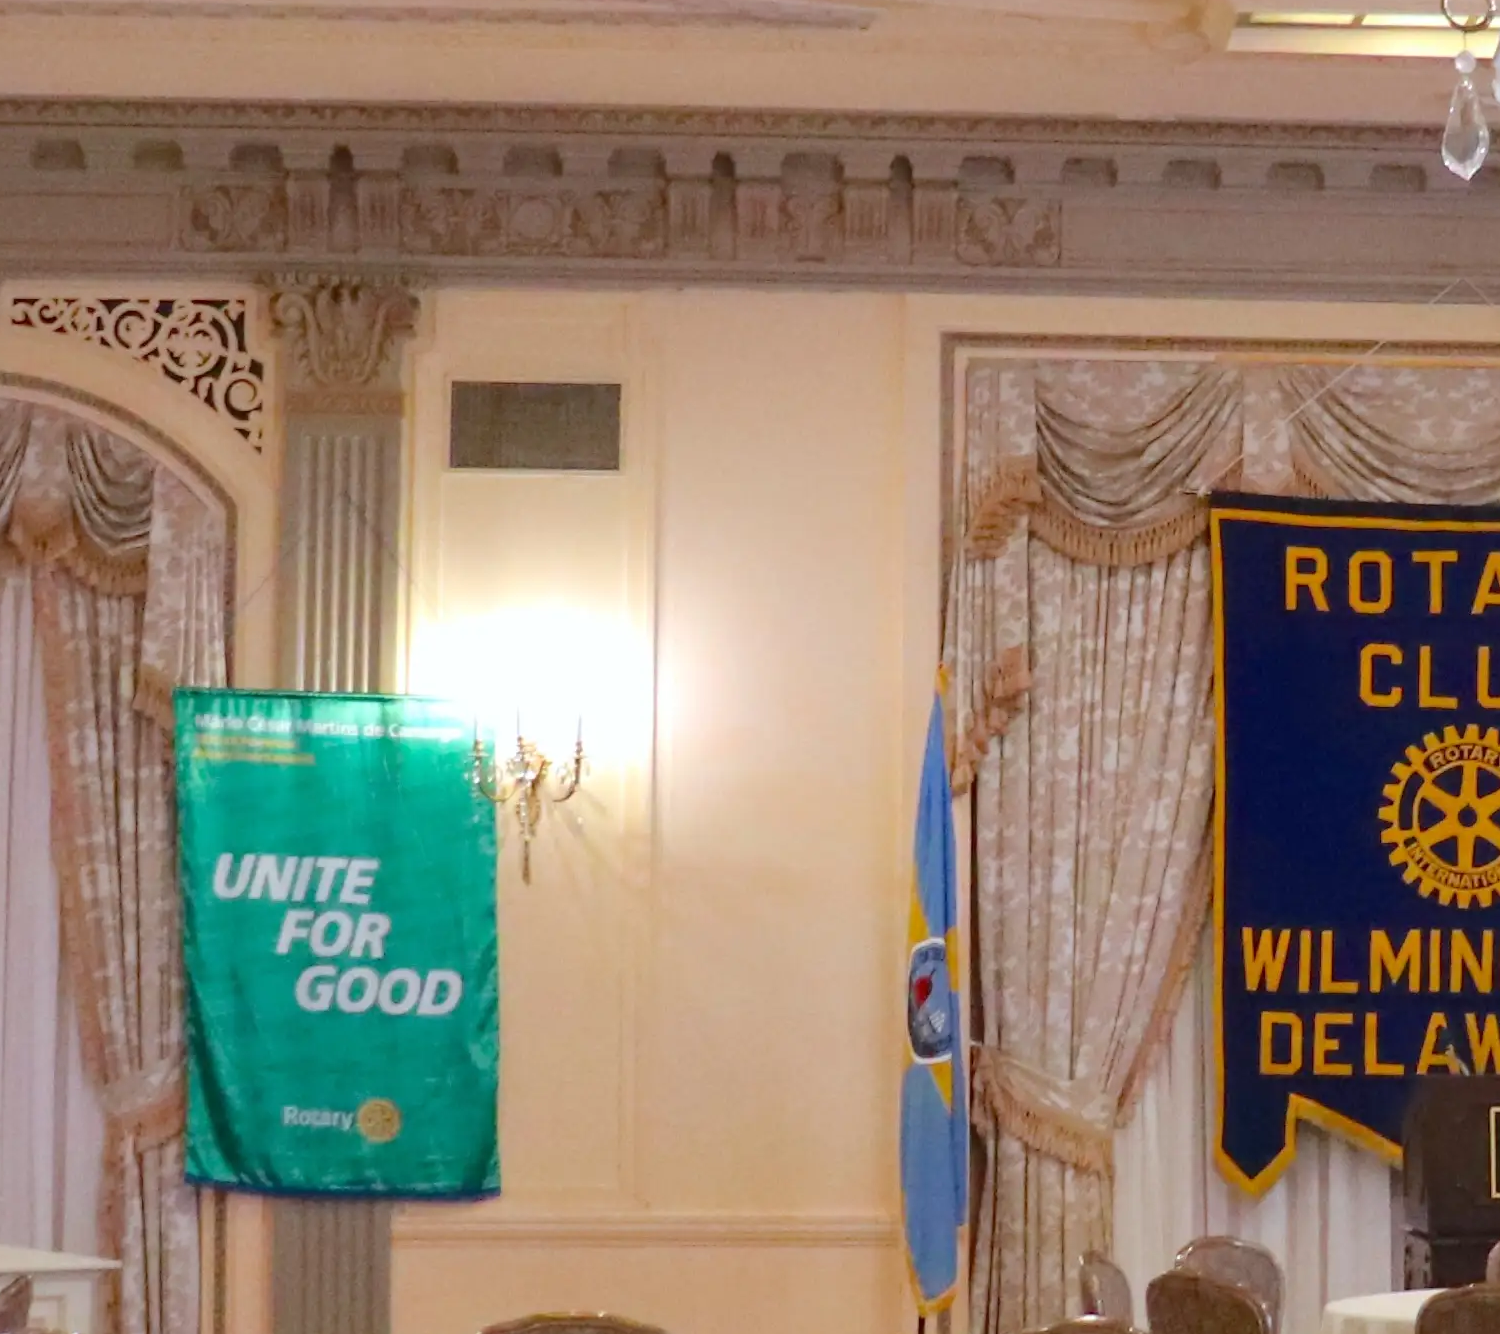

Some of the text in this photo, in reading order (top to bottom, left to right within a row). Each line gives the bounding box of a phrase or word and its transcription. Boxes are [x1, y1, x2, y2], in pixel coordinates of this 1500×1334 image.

[213, 853, 380, 905] UNITE
[275, 909, 391, 959] FOR
[294, 964, 464, 1016] GOOD
[283, 1105, 355, 1132] Rotary
